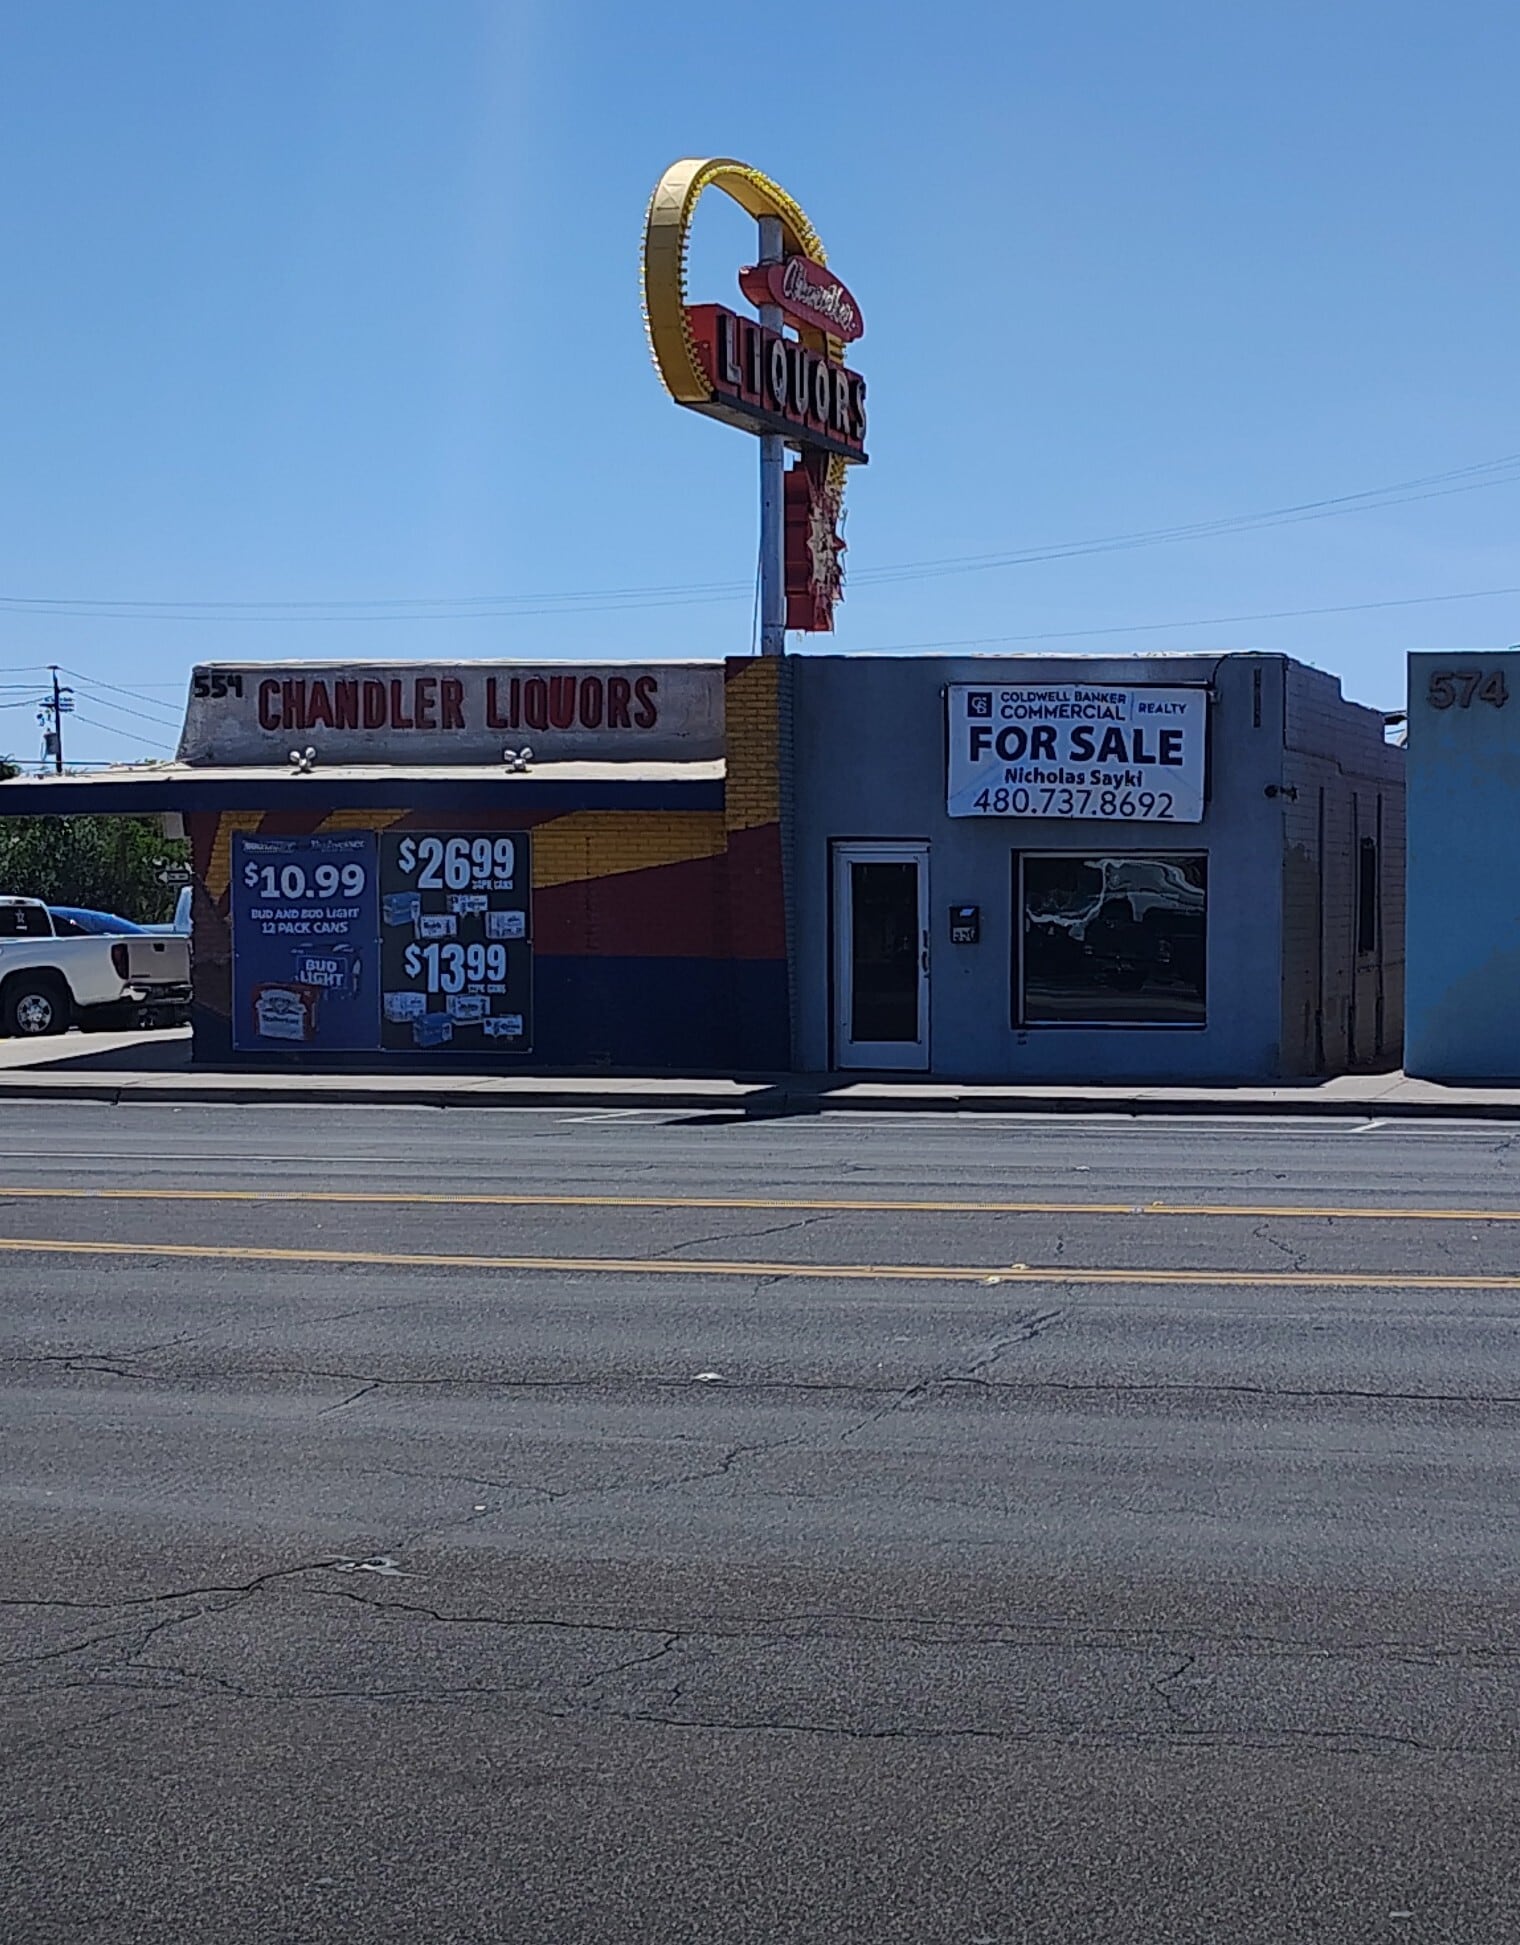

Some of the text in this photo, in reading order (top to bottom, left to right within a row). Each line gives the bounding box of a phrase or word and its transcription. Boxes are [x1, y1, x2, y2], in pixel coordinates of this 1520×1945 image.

[720, 314, 867, 440] LIQUORS
[194, 674, 243, 699] 554
[1000, 690, 1127, 705] COLDWELL BANKER
[1427, 669, 1509, 710] 574
[258, 675, 659, 732] CHANDLER LIQUORS
[1000, 703, 1126, 721] COMMERCIAL
[1138, 702, 1187, 715] REALTY
[970, 725, 1184, 766] FOR SALE
[1004, 767, 1143, 790] Nicholas Sayki
[973, 788, 1175, 819] 480.737.8692
[244, 861, 366, 899] $10.99
[278, 921, 312, 934] PACK
[313, 921, 349, 934] CANS
[299, 970, 345, 987] LIGHT
